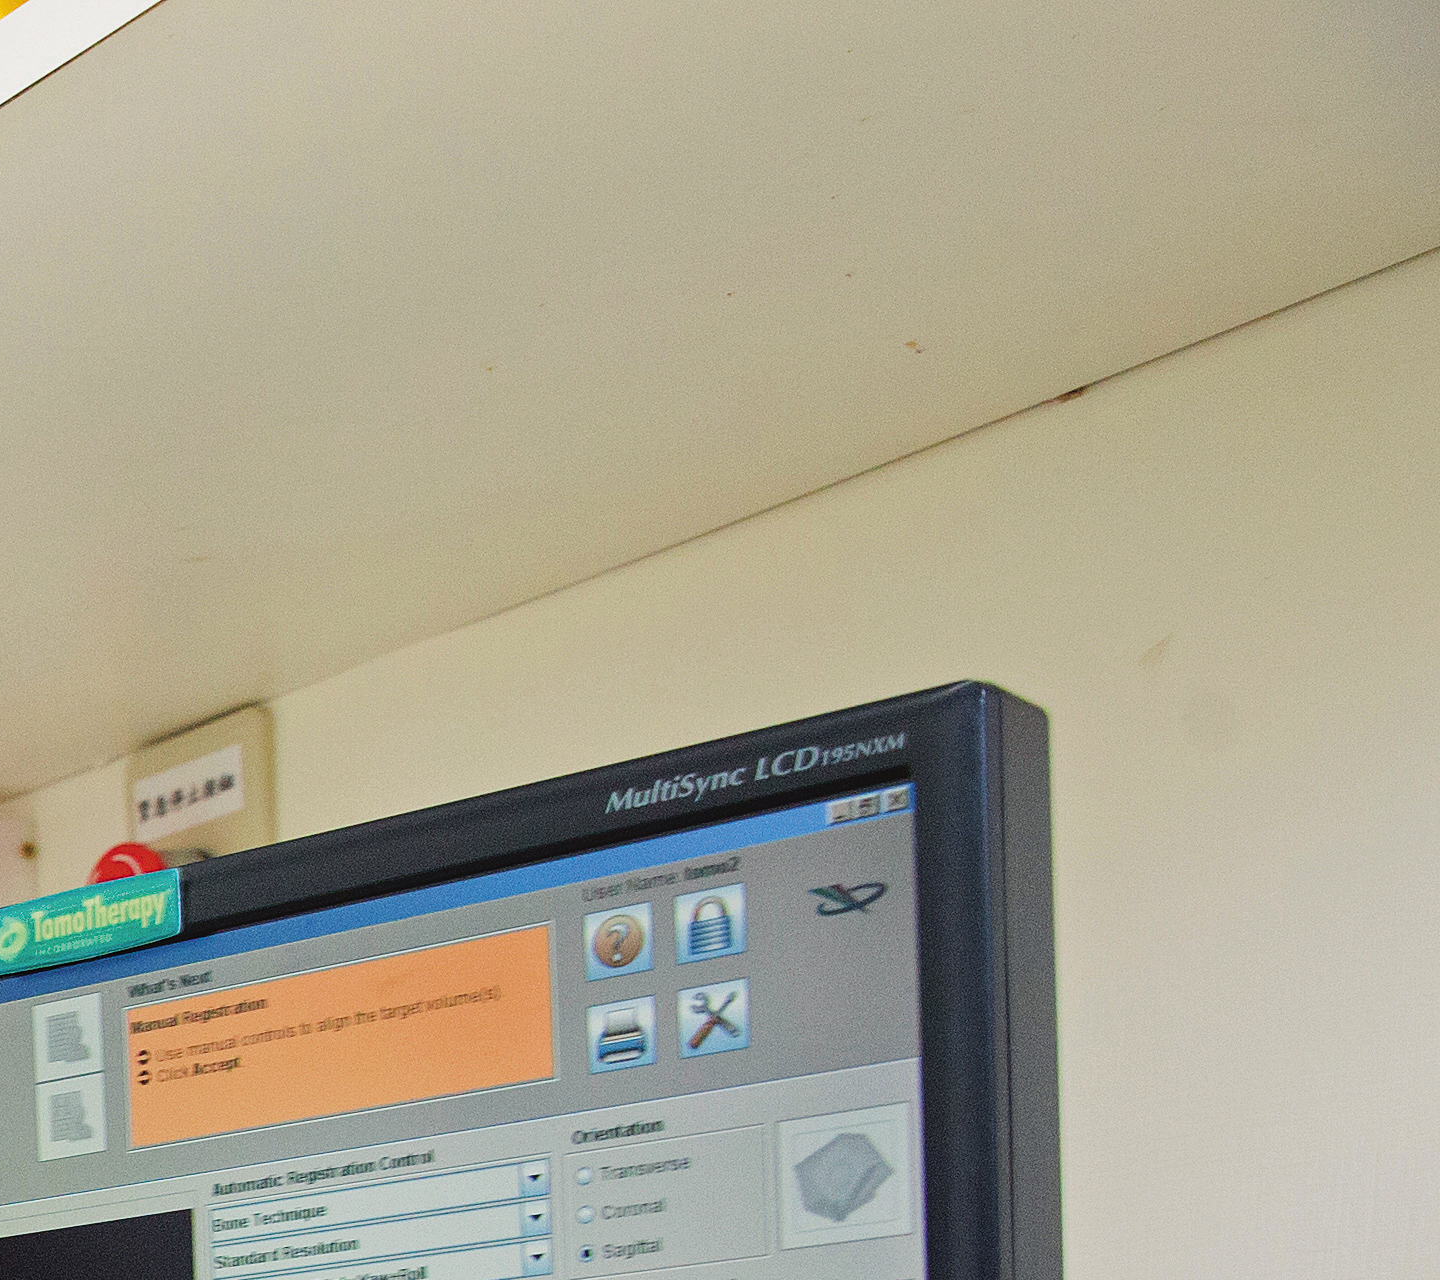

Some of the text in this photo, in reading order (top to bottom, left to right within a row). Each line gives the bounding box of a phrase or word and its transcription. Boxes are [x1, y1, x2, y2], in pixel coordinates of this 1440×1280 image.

[605, 766, 747, 815] MultiSync
[31, 889, 171, 943] TomoTherapy
[131, 997, 269, 1033] Manual Registration
[154, 1047, 183, 1062] Use
[187, 1035, 238, 1056] manual
[240, 1024, 297, 1047] controls
[318, 1012, 352, 1035] align
[354, 1009, 377, 1024] the
[379, 999, 424, 1021] target
[571, 1119, 666, 1145] Orientation
[212, 1149, 435, 1197] Automatic Registration Control
[600, 1157, 692, 1180] Transverse
[212, 1203, 328, 1233] Bone Technique
[601, 1199, 668, 1221] Coronal
[213, 1237, 360, 1270] Standard Resolution
[602, 1237, 664, 1260] Sagittal
